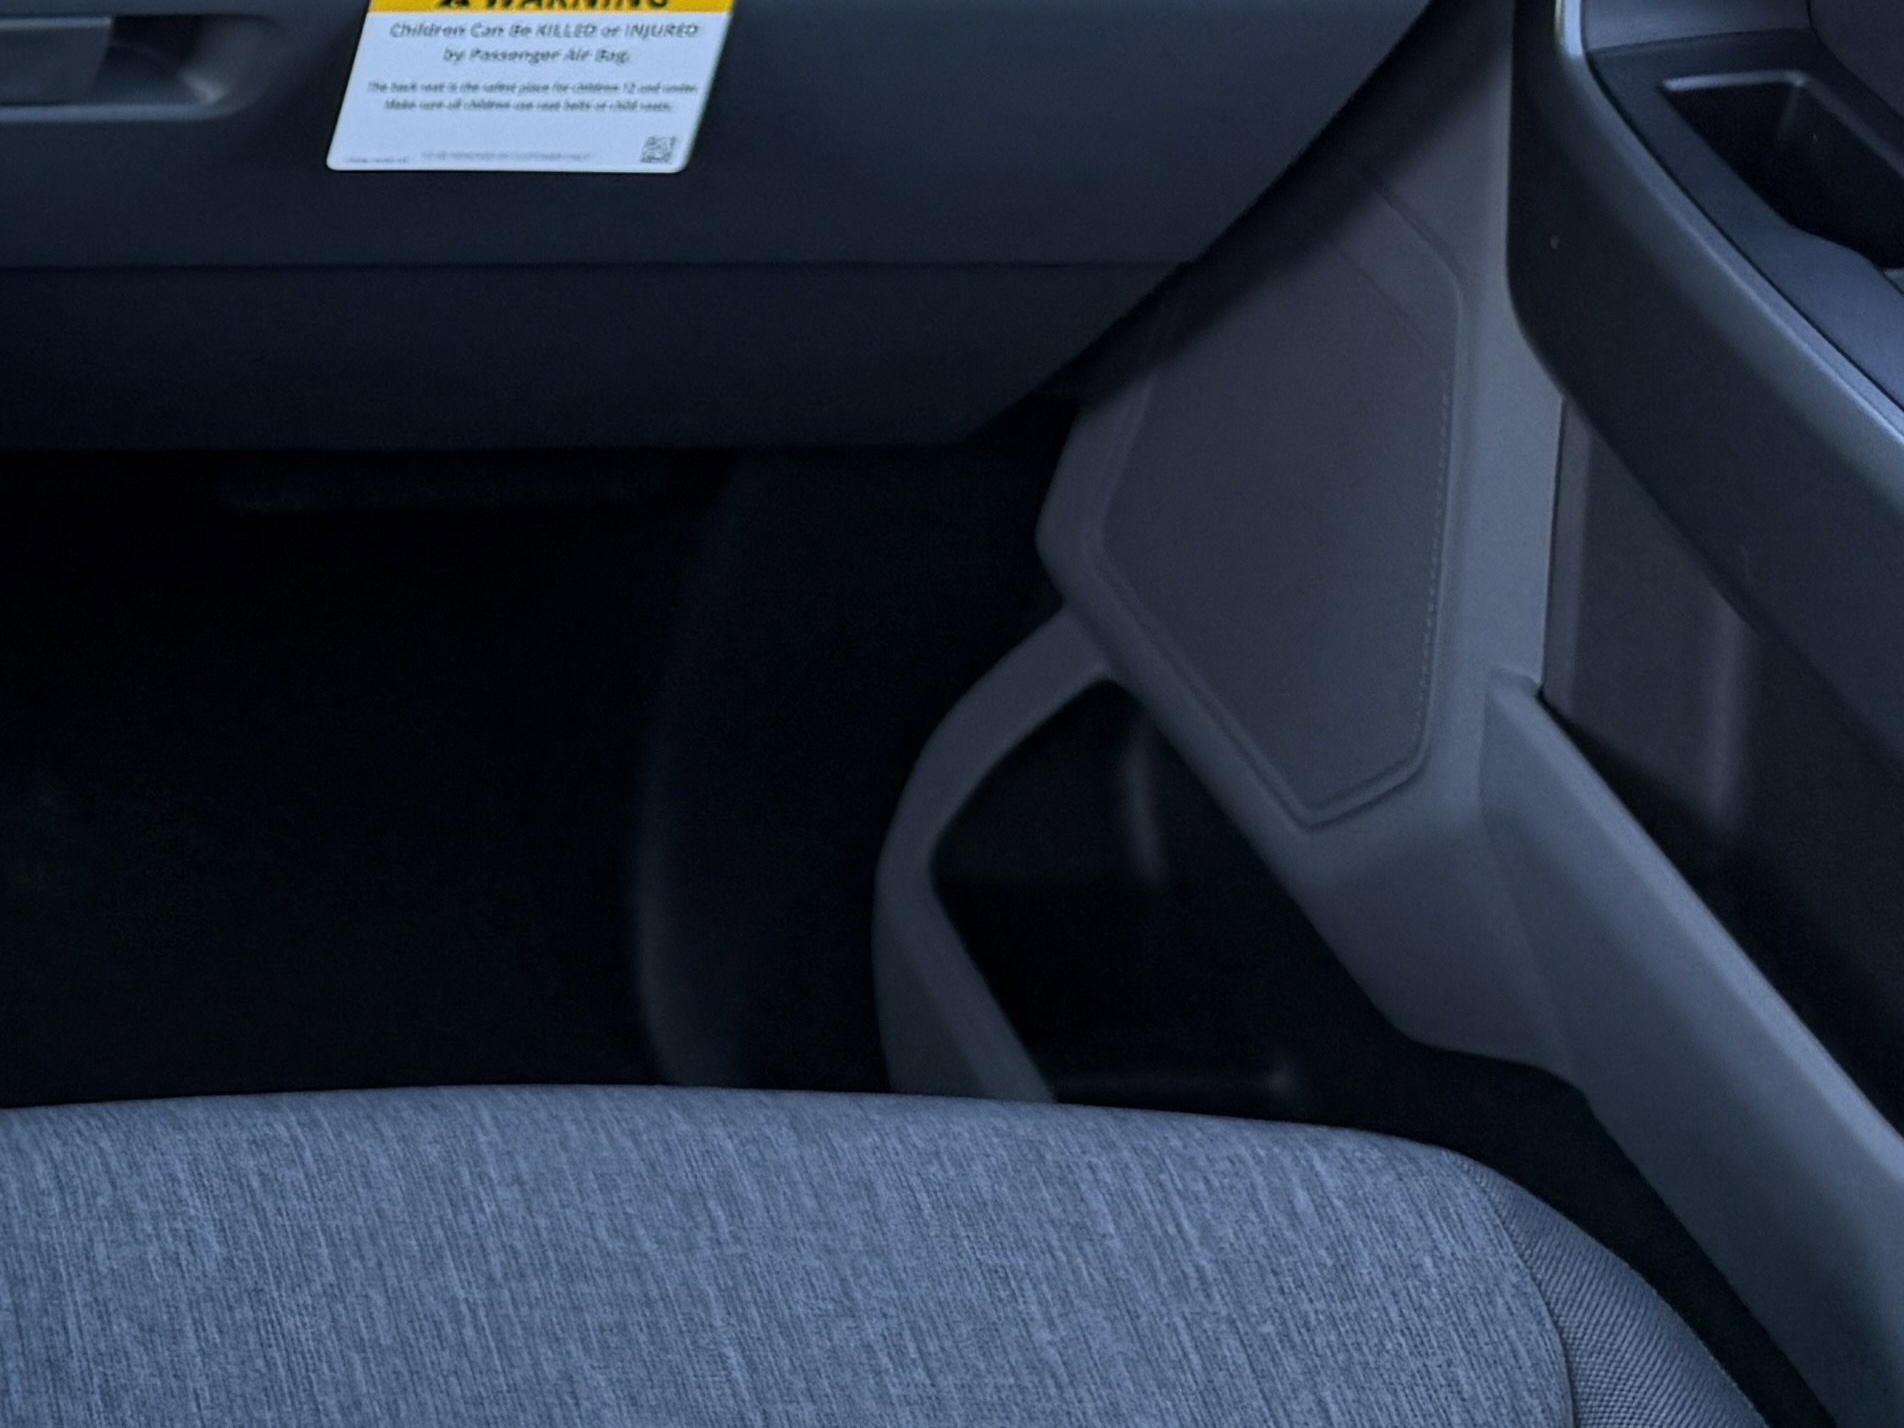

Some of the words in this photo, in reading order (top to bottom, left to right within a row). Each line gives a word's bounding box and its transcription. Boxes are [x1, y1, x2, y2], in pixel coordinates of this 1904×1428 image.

[390, 22, 465, 39] Children
[470, 23, 504, 39] Can
[508, 23, 531, 39] Be
[535, 23, 598, 39] KILLED
[601, 27, 622, 40] or
[624, 23, 700, 41] INJURED
[443, 48, 465, 64] by
[469, 48, 562, 65] Passenger
[565, 48, 592, 63] Air
